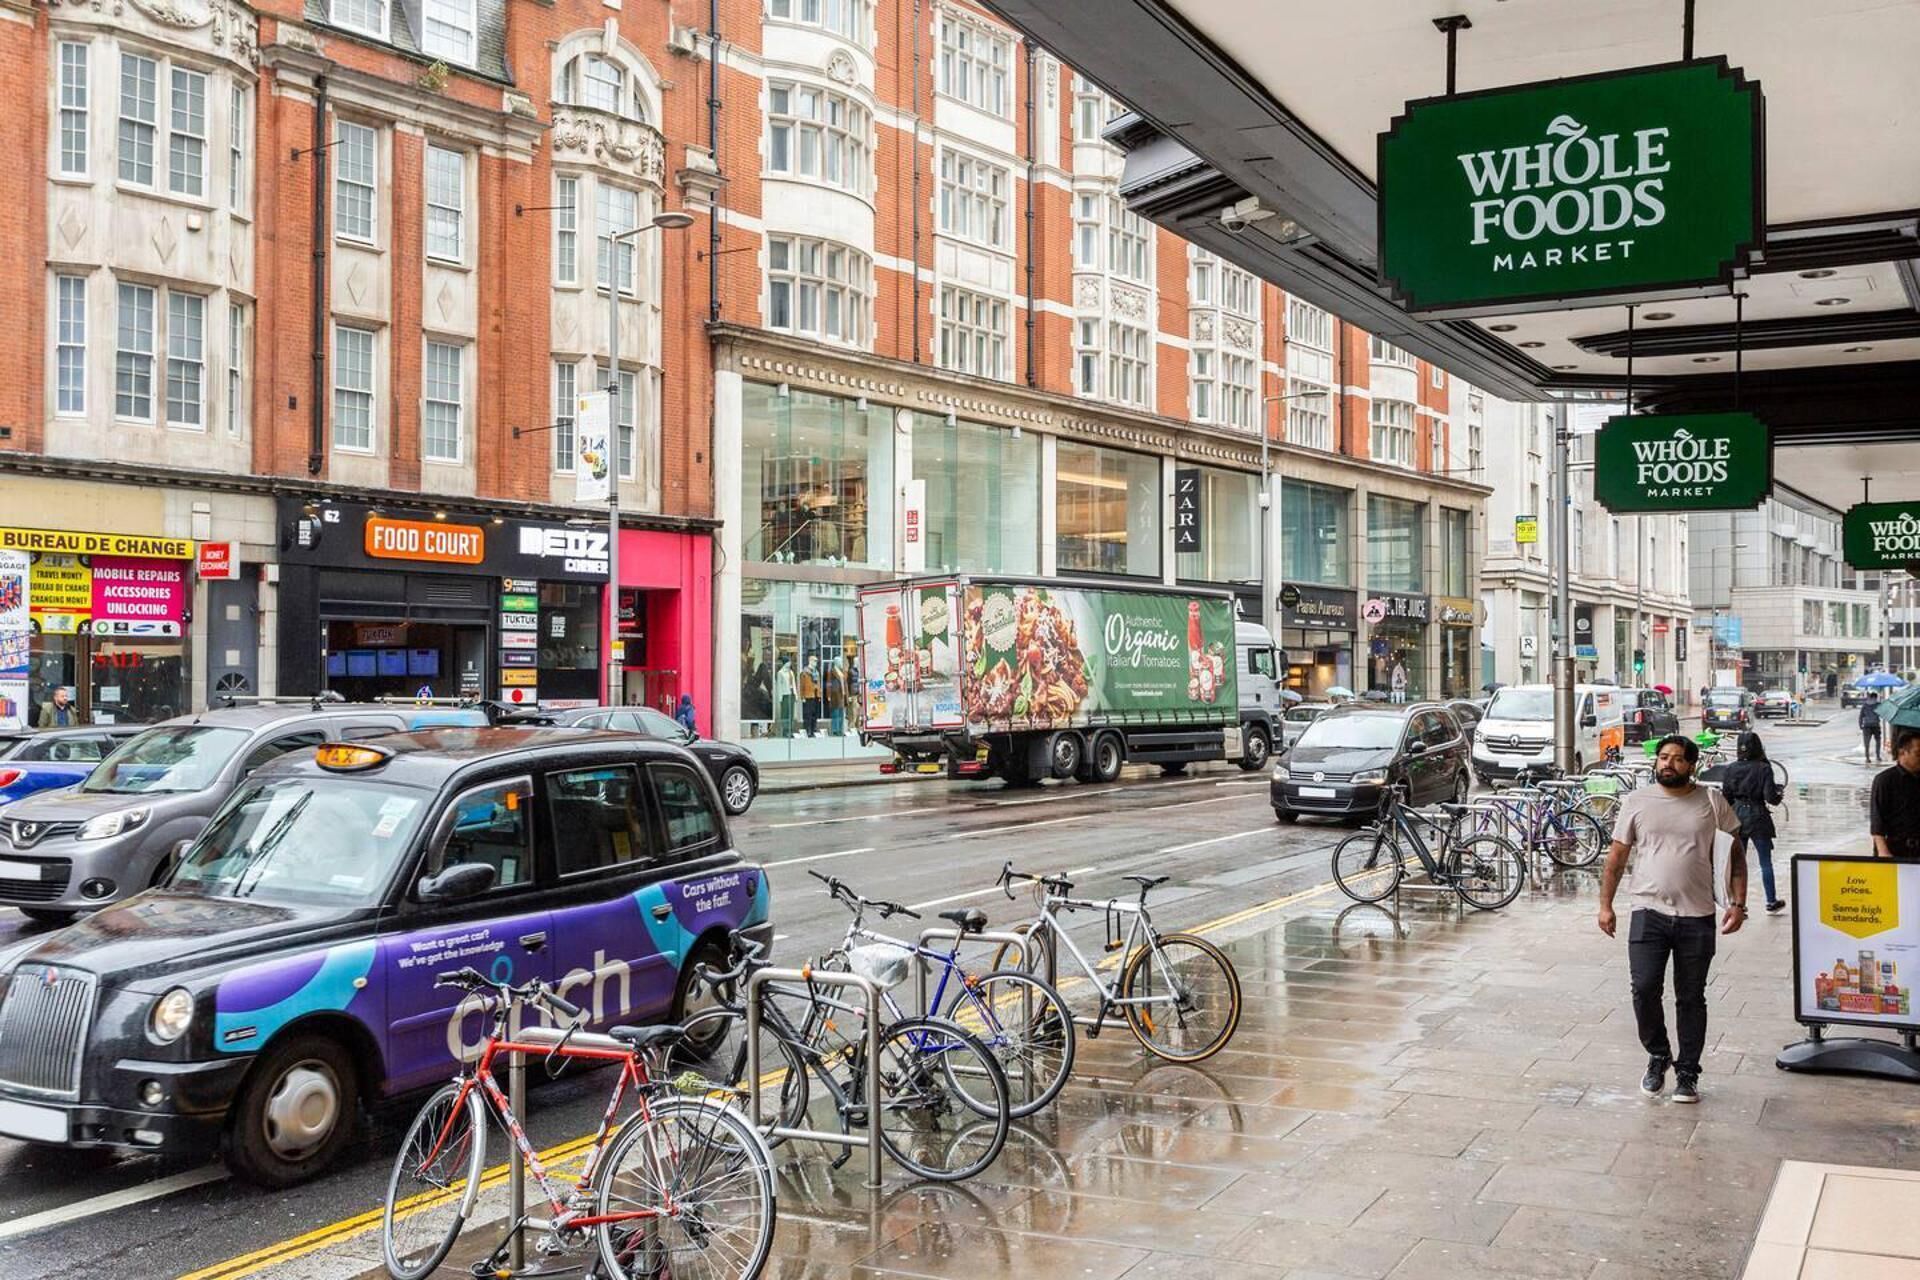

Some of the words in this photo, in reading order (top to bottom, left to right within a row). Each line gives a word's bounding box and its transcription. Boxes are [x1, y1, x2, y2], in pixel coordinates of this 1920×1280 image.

[1457, 116, 1671, 196] WHOLE
[1470, 179, 1666, 244] FOODS
[1493, 240, 1634, 272] MARKET
[1632, 428, 1731, 462] WHOLE
[1637, 461, 1728, 484] FOODS
[1647, 487, 1714, 497] MARKET
[1178, 479, 1195, 543] ZARA
[1869, 513, 1920, 536] WHO
[3, 532, 80, 549] BUREAU
[85, 537, 110, 551] DE
[115, 539, 186, 555] CHANGE
[374, 525, 419, 552] FOOD
[425, 530, 479, 556] COURT
[1873, 536, 1920, 551] FOO
[1881, 552, 1920, 560] MARKE
[36, 570, 59, 578] TRAVEL
[61, 571, 83, 580] MONEY
[93, 568, 134, 580] MOBILE
[136, 569, 180, 582] REPAIRS
[66, 596, 88, 604] MONEY
[104, 586, 171, 599] ACCESSORIES
[106, 602, 168, 615] UNLOCKING
[504, 615, 536, 624] TUKTUK
[1125, 615, 1163, 627] Authentic
[1105, 613, 1179, 668] Organic
[1142, 654, 1181, 667] Tomatoes
[322, 747, 356, 764] TAX
[683, 884, 705, 898] Cars
[706, 873, 740, 892] without
[1847, 876, 1867, 884] Low
[1840, 886, 1873, 895] prices.
[696, 898, 711, 912] the
[712, 891, 732, 908] faff.
[1832, 903, 1859, 913] Same
[1861, 905, 1882, 916] high
[1832, 914, 1882, 924] standards.
[410, 938, 438, 952] Want
[438, 939, 445, 948] a
[445, 934, 471, 950] great
[471, 929, 490, 943] car?
[398, 956, 426, 969] We've
[427, 951, 445, 966] got
[444, 948, 458, 961] the
[458, 940, 505, 958] knowledge
